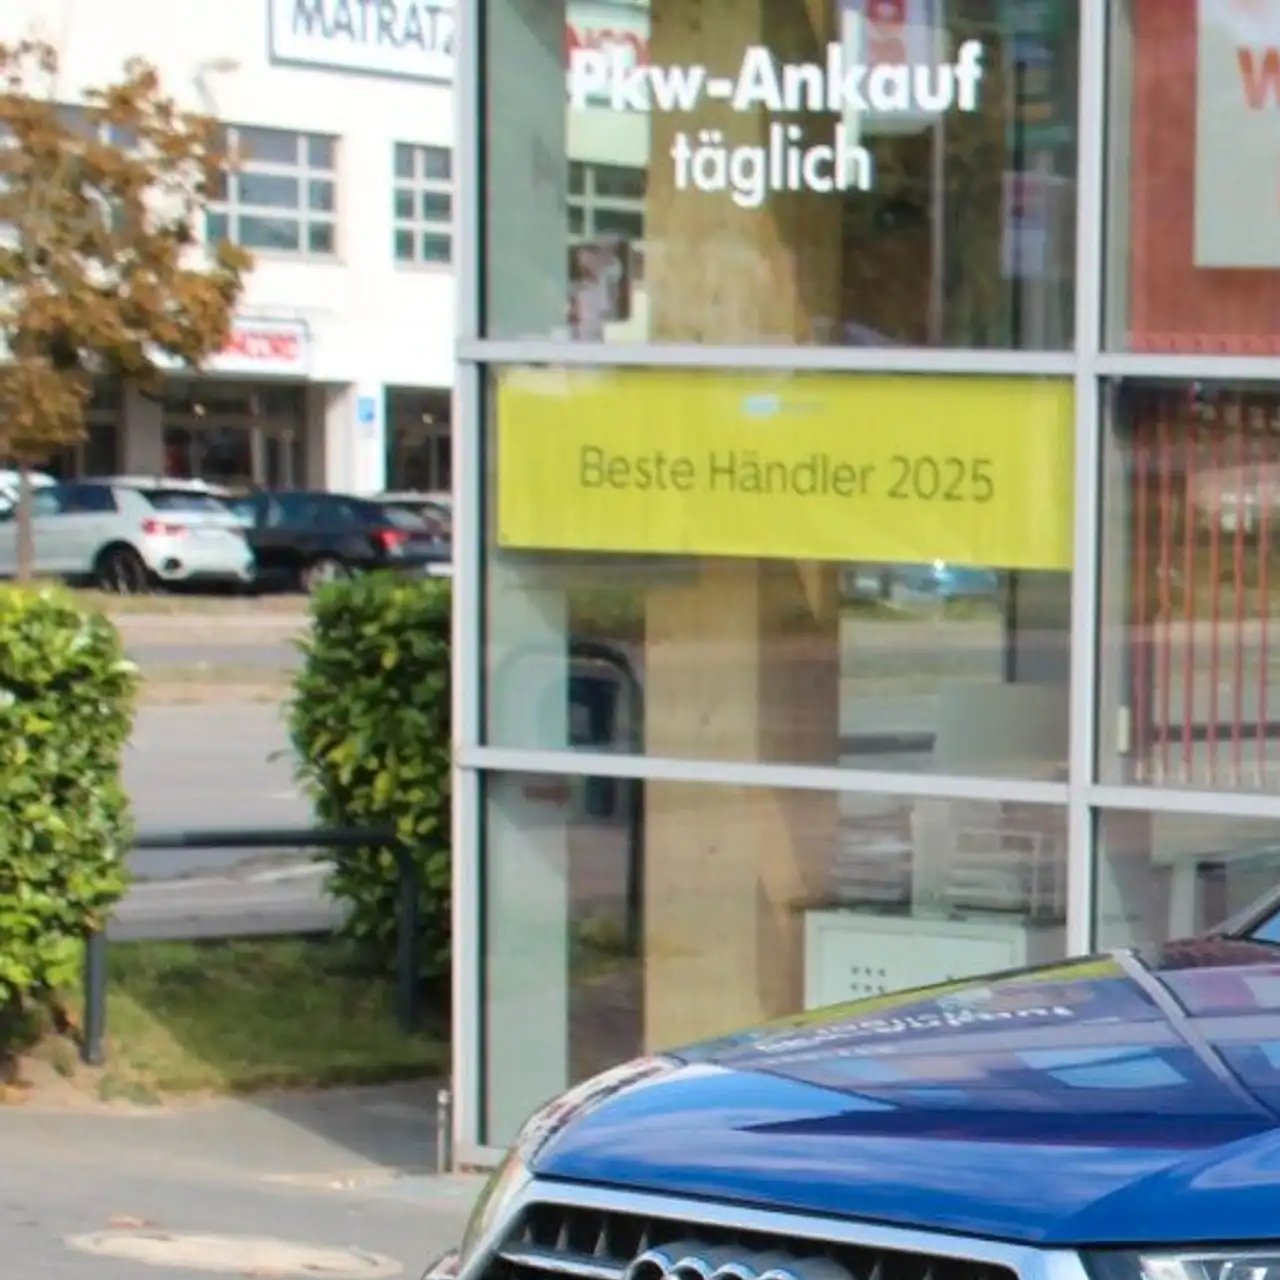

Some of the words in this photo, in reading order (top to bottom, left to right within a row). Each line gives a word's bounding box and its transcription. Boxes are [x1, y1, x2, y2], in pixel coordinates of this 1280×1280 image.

[568, 40, 983, 112] Pkw-Ankauf
[671, 122, 873, 207] täglich
[579, 445, 695, 492] Beste
[708, 451, 876, 498] Händler
[887, 455, 996, 503] 2025
